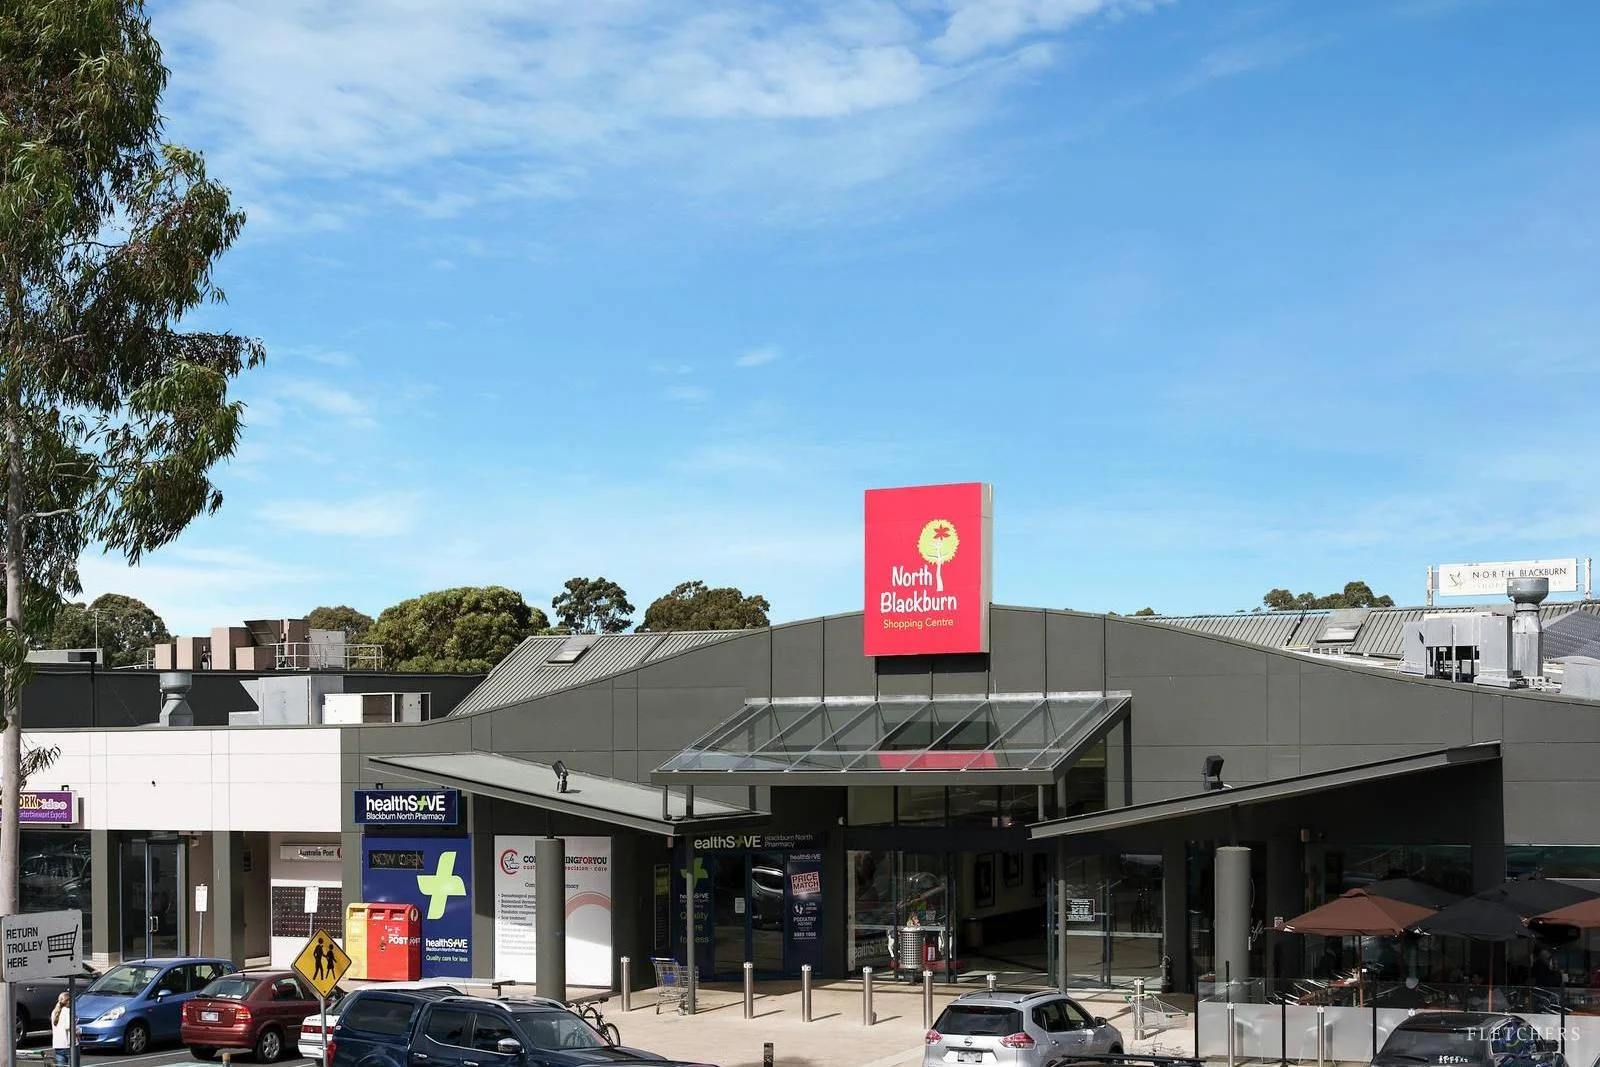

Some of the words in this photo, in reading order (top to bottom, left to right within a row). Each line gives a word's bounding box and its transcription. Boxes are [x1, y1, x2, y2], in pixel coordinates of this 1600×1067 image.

[892, 565, 932, 587] North
[1519, 567, 1567, 578] BLACKBURN
[880, 590, 957, 613] Blackburn
[883, 619, 922, 630] Shopping
[925, 618, 954, 627] Centre
[366, 812, 396, 820] Blackburn
[396, 812, 415, 820] North
[415, 812, 446, 822] Pharmacy
[792, 873, 818, 883] PRICE
[793, 881, 819, 891] MATCH
[6, 927, 39, 940] RETURN
[388, 936, 408, 945] POST
[7, 940, 43, 954] TROLLEY
[7, 956, 28, 968] HERE
[425, 954, 442, 962] Quality
